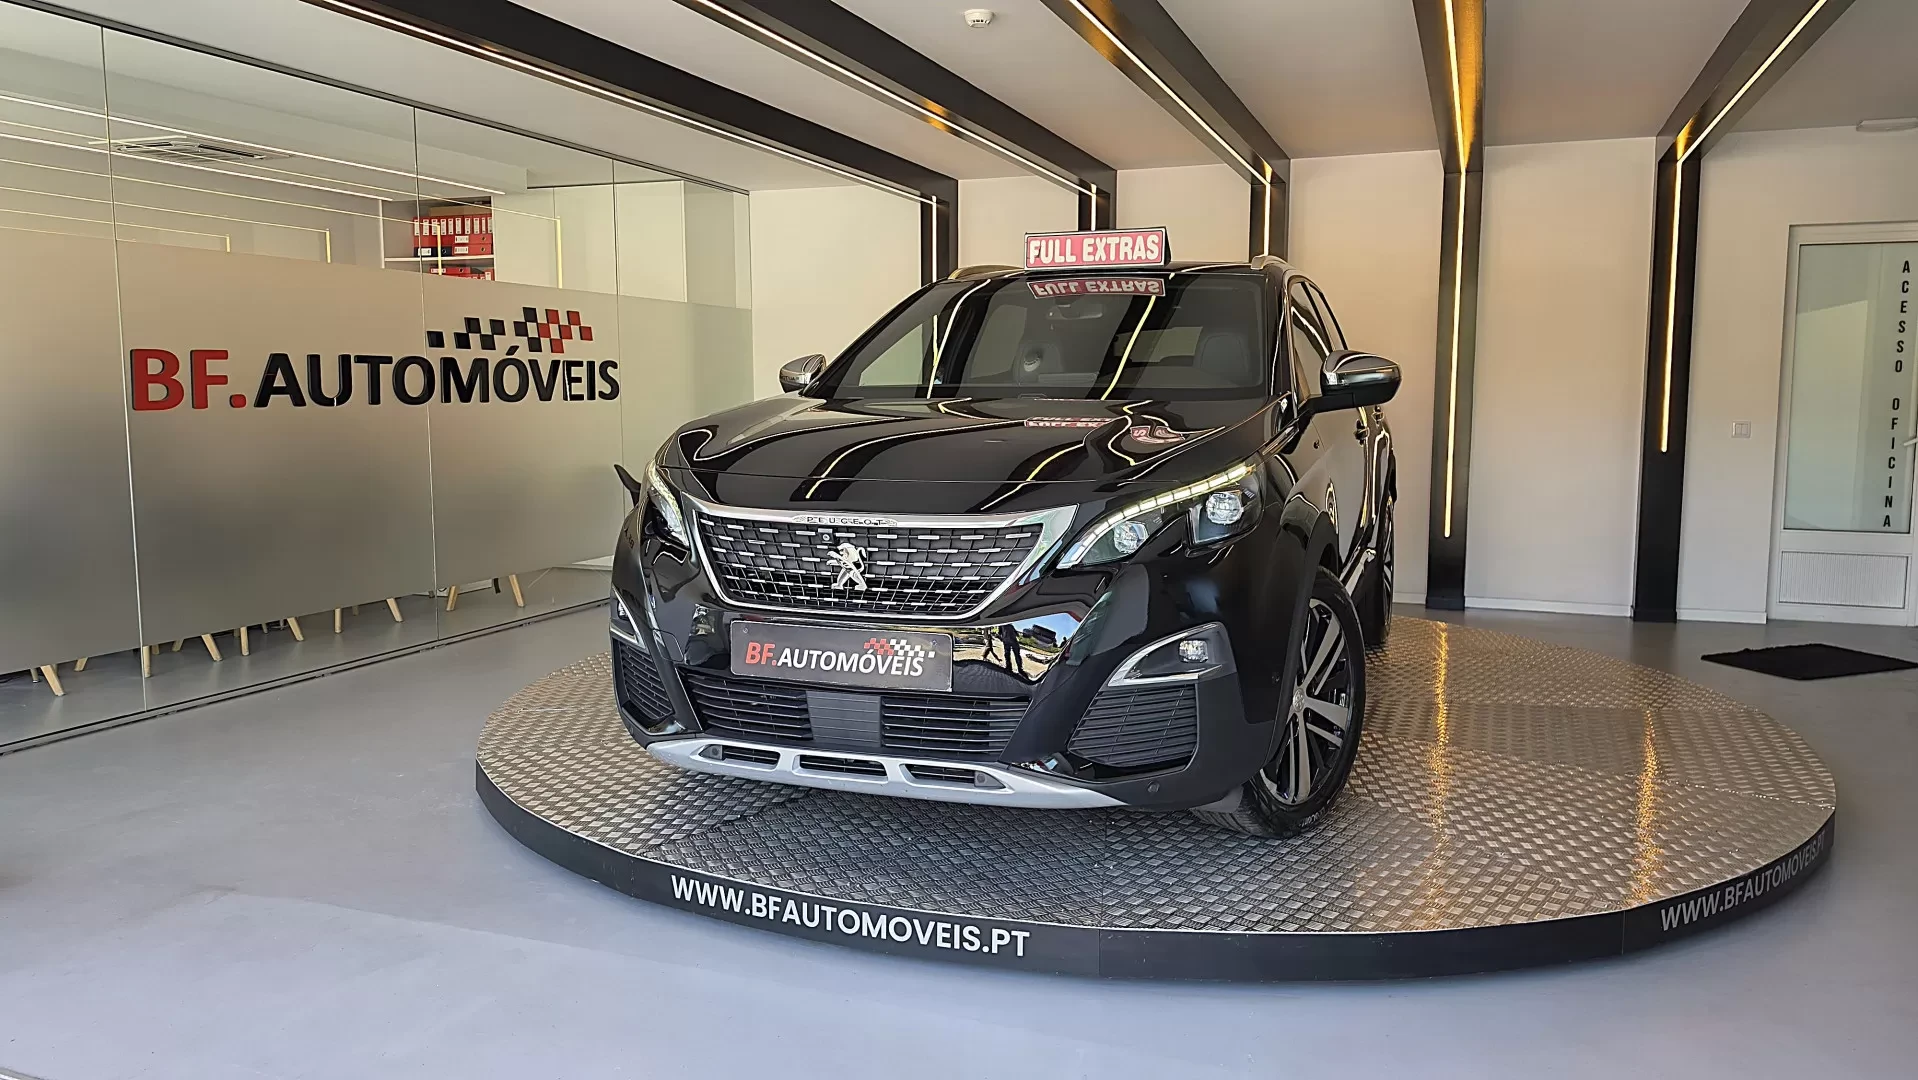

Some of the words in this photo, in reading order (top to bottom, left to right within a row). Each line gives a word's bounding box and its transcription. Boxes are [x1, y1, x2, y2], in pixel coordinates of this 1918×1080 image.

[1028, 238, 1077, 265] FULL
[1082, 234, 1160, 263] EXTRAS
[1894, 260, 1911, 373] ACESSO
[1882, 397, 1900, 528] OFICINA
[806, 515, 886, 526] PEUGEOT
[670, 874, 1031, 958] WWW.BFAUTOMOVEIS.PT
[1661, 831, 1825, 931] WWW.BFAUTOMOVEIS.PT
